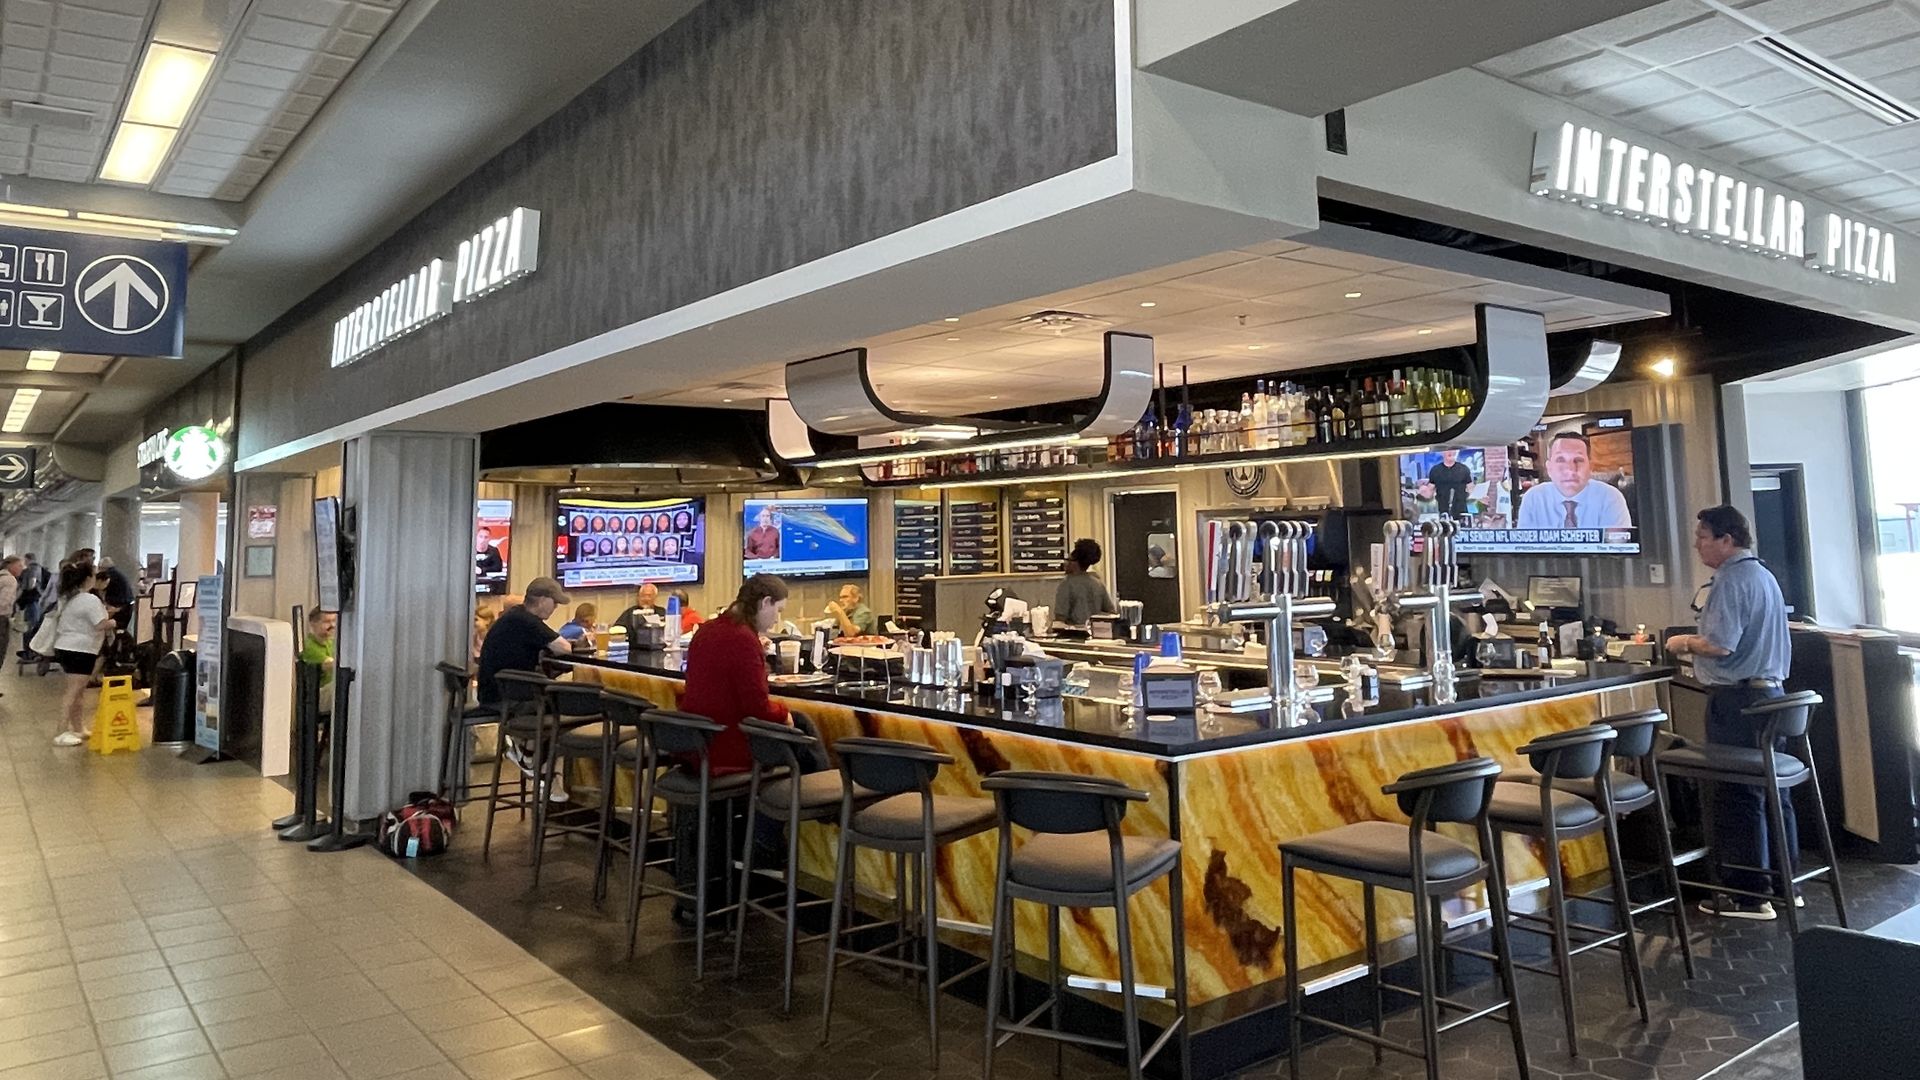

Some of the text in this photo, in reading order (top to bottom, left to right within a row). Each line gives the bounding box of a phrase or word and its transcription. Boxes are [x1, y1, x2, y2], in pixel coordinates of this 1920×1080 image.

[1556, 121, 1897, 284] INTERSTELLAR PIZZA
[331, 206, 525, 368] INTERSTELLAR PIZZA
[1454, 529, 1600, 543] SPN SENIOR NFL INSIDER ADAM SCHEFTER
